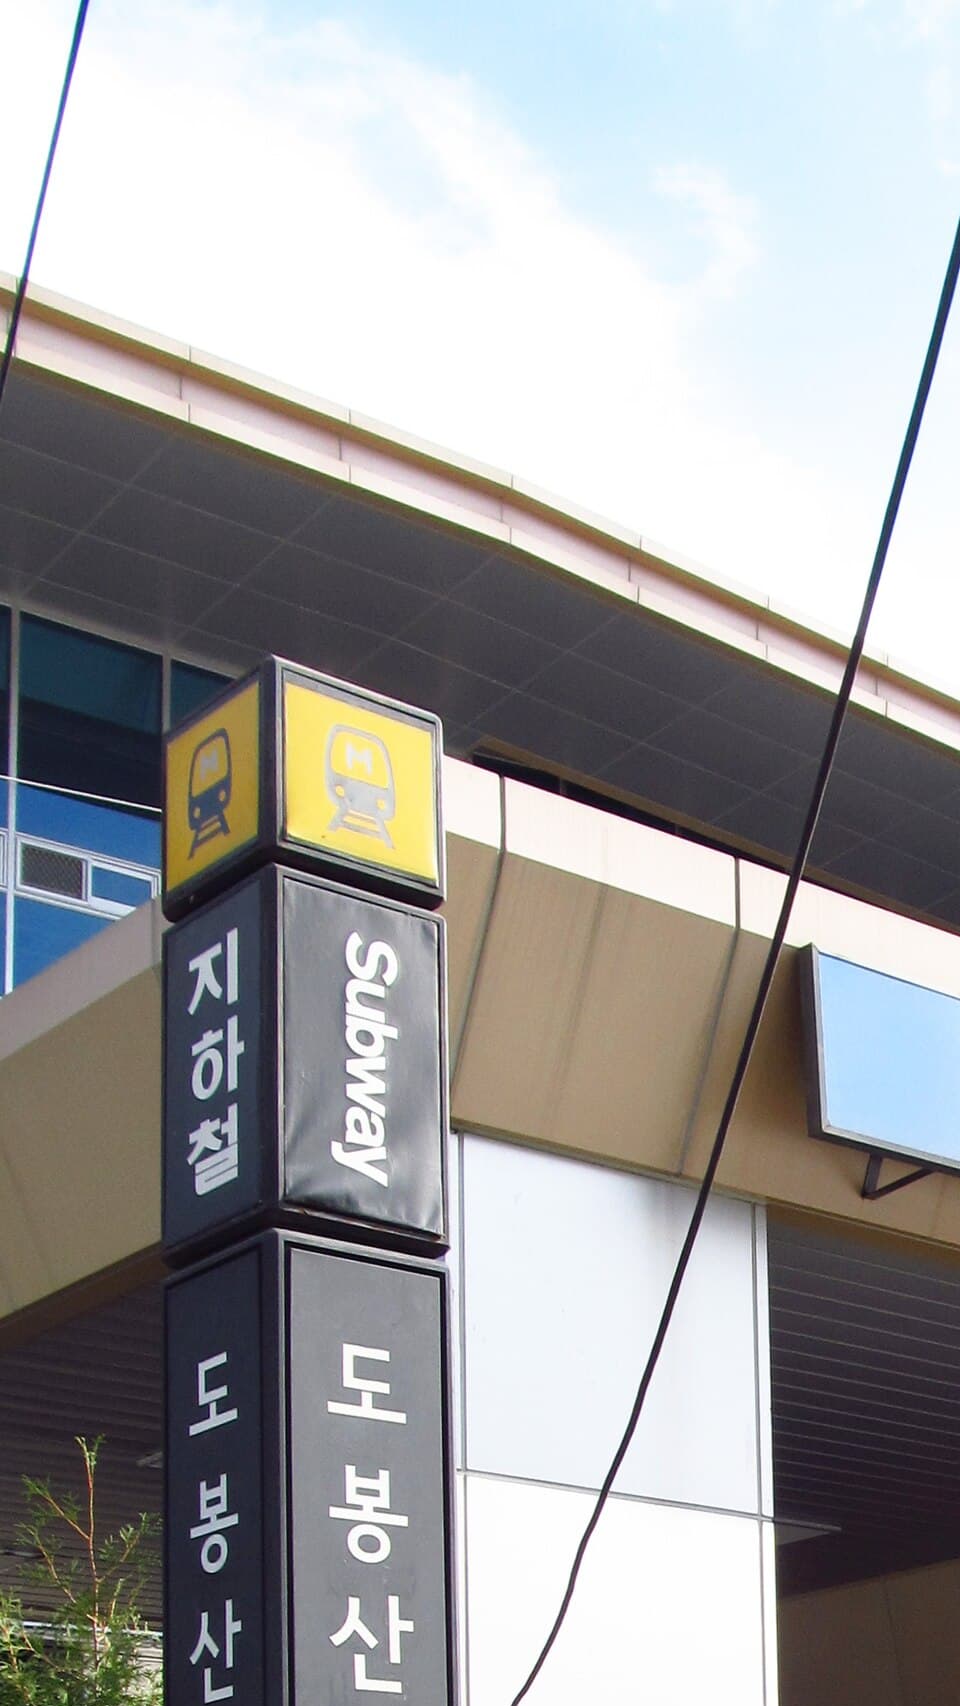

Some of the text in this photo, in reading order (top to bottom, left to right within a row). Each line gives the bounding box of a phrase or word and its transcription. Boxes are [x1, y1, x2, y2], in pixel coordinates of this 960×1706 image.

[188, 927, 245, 1196] 지하철
[331, 931, 398, 1188] Subway
[189, 1352, 243, 1705] 도봉산
[327, 1342, 415, 1695] 도봉산
